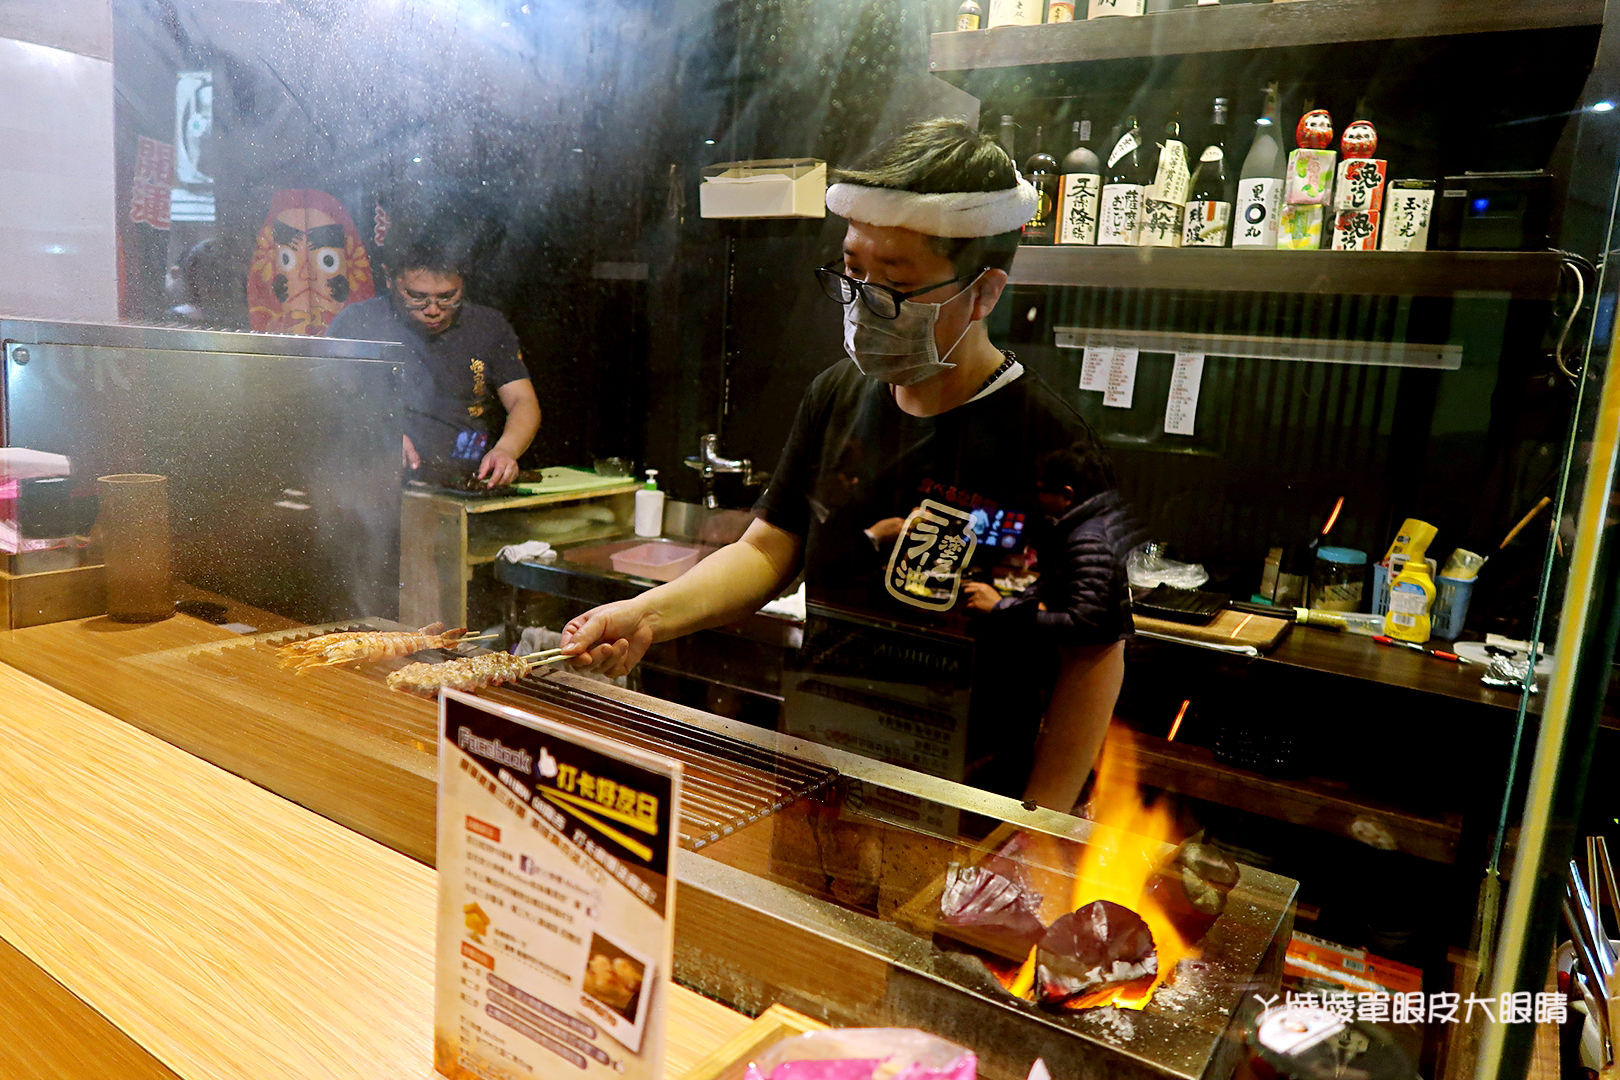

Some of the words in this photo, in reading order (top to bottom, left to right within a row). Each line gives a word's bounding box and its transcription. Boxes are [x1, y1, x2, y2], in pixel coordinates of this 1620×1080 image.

[1400, 196, 1421, 238] 玉乃光
[458, 725, 532, 775] Facebook
